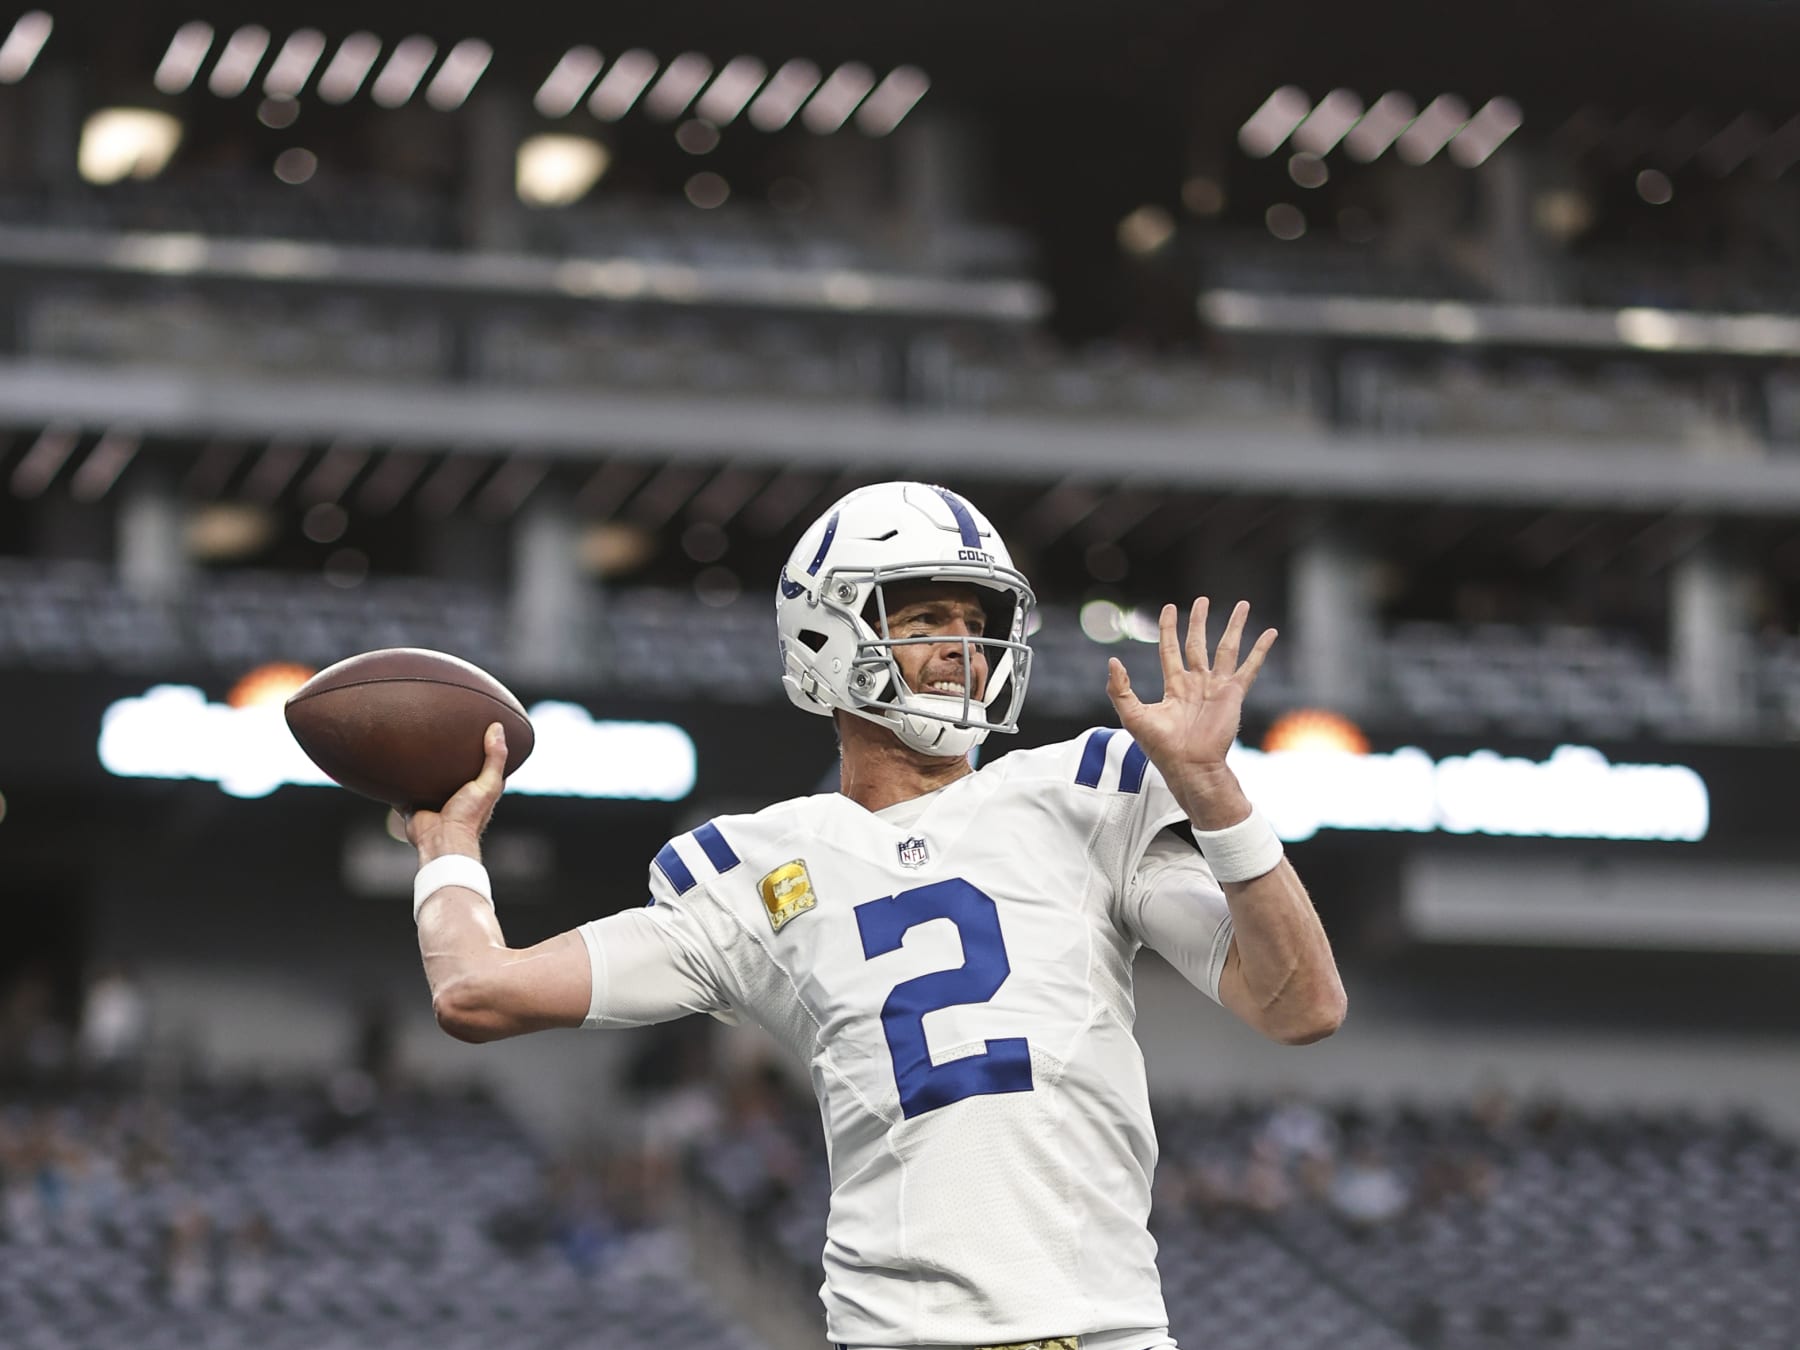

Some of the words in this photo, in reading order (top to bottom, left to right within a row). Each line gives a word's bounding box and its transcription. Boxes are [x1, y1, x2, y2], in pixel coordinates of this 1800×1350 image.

[958, 550, 995, 563] COLTS
[903, 848, 925, 862] NFL
[853, 877, 1034, 1120] 2
